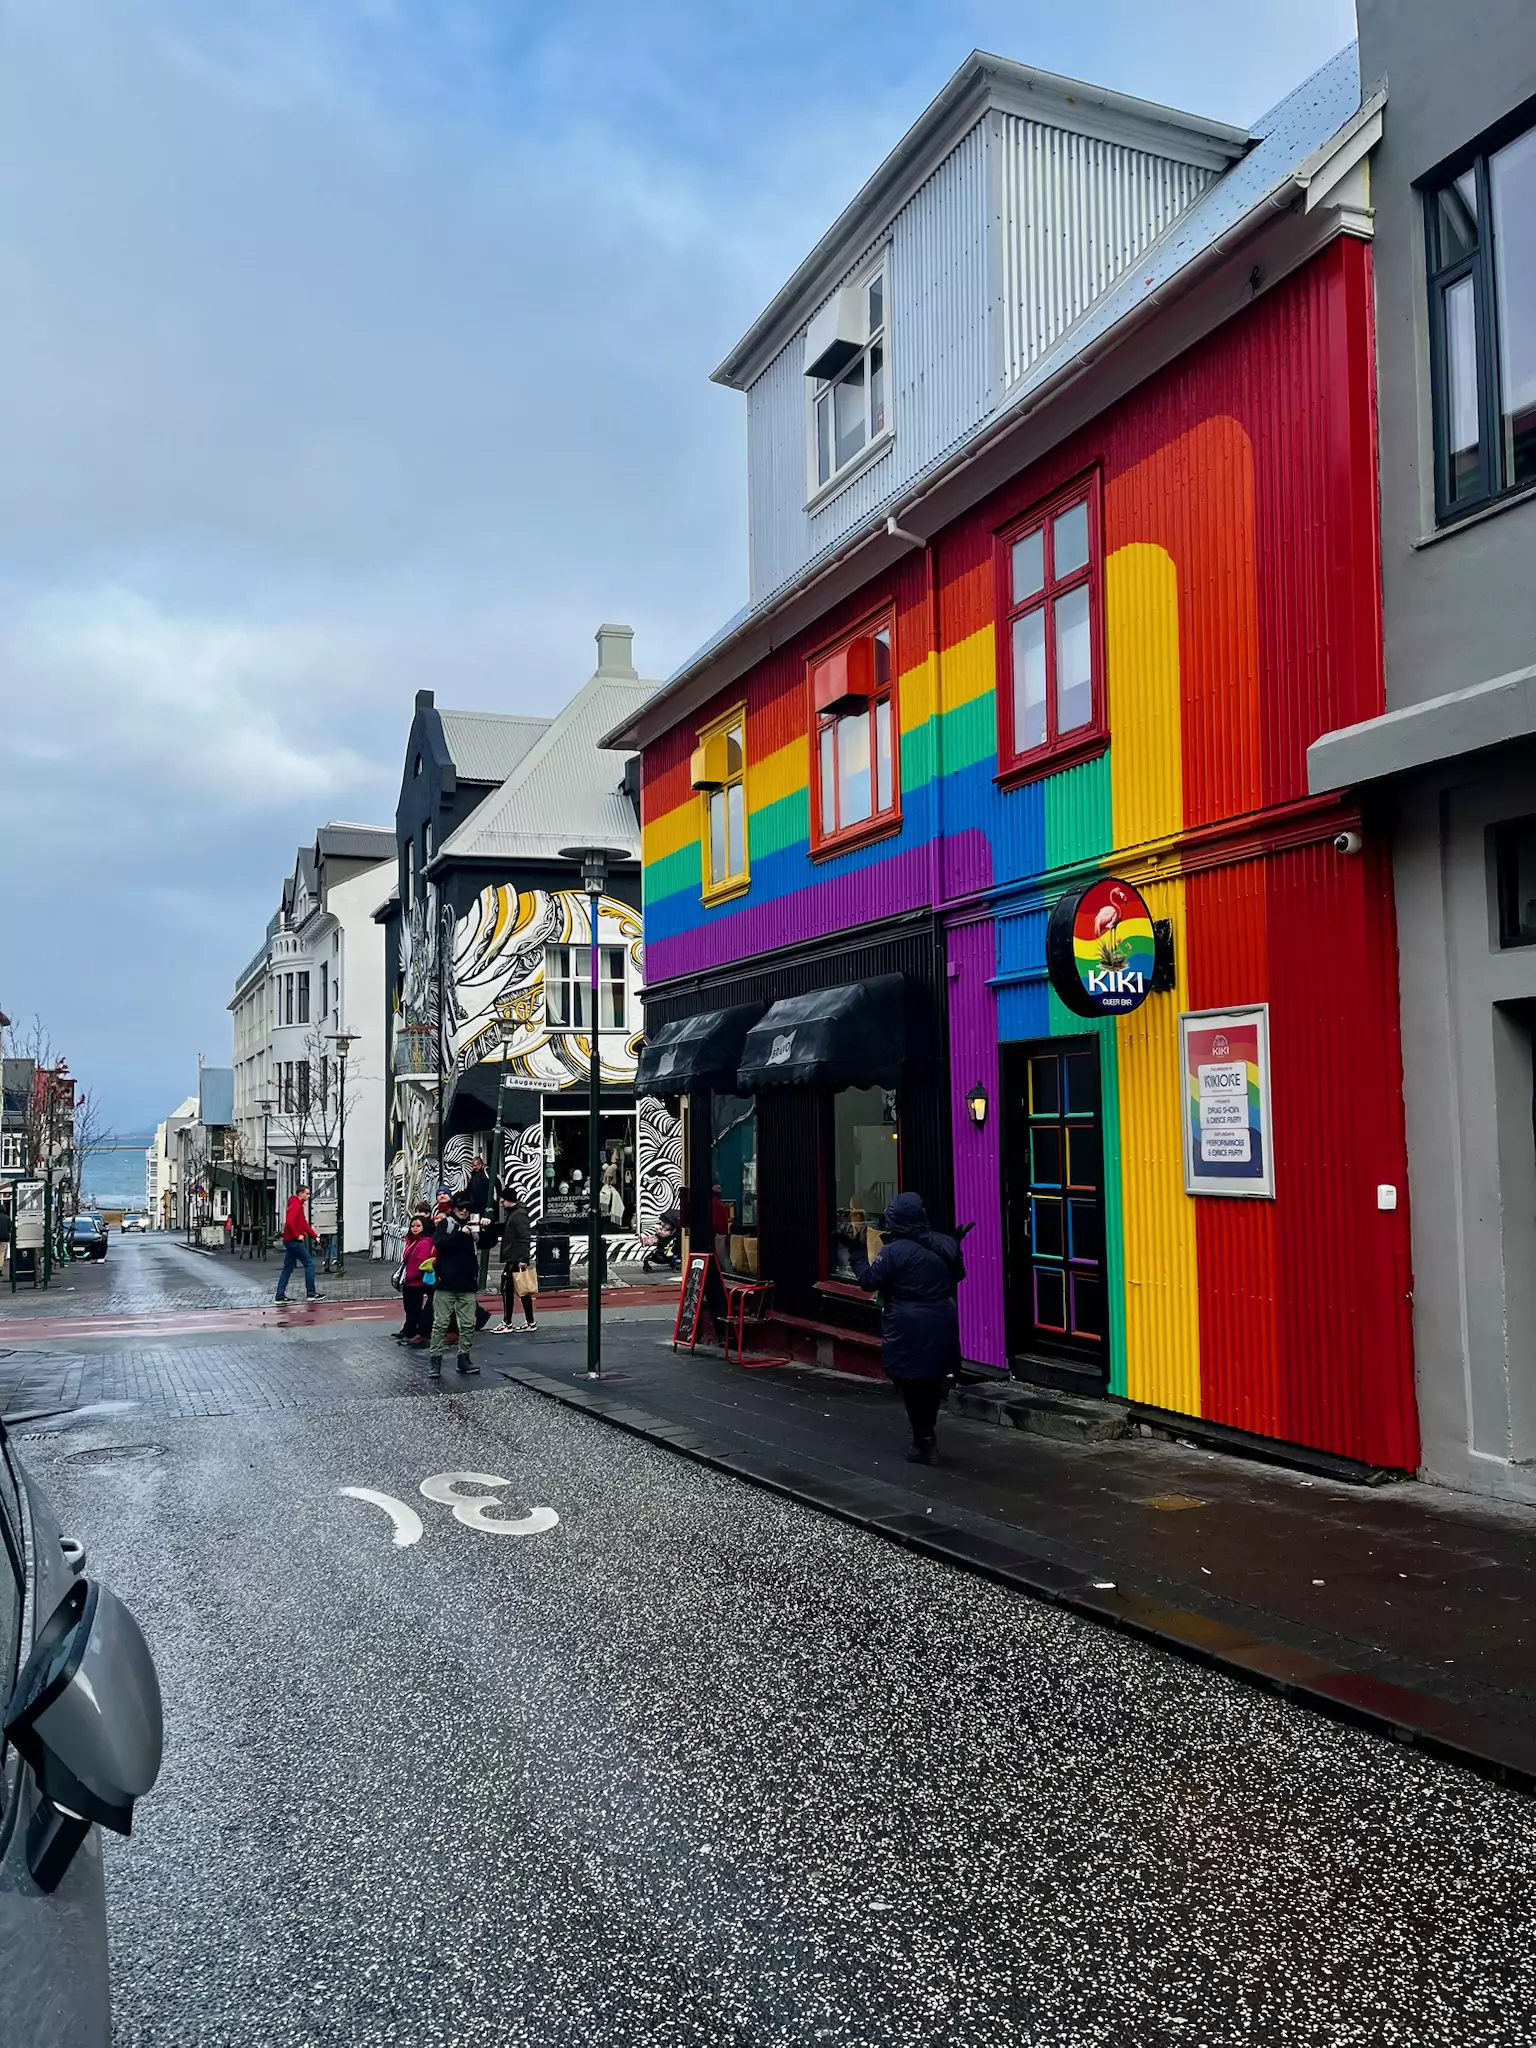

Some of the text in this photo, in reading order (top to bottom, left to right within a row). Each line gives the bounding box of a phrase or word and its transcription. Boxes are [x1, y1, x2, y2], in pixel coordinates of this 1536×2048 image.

[1088, 970, 1144, 993] KIKI
[1102, 998, 1132, 1006] QUEER BAR
[1212, 1046, 1230, 1056] KIKI
[509, 1078, 556, 1088] Laugavegur
[1204, 1073, 1241, 1088] KIKIOKE
